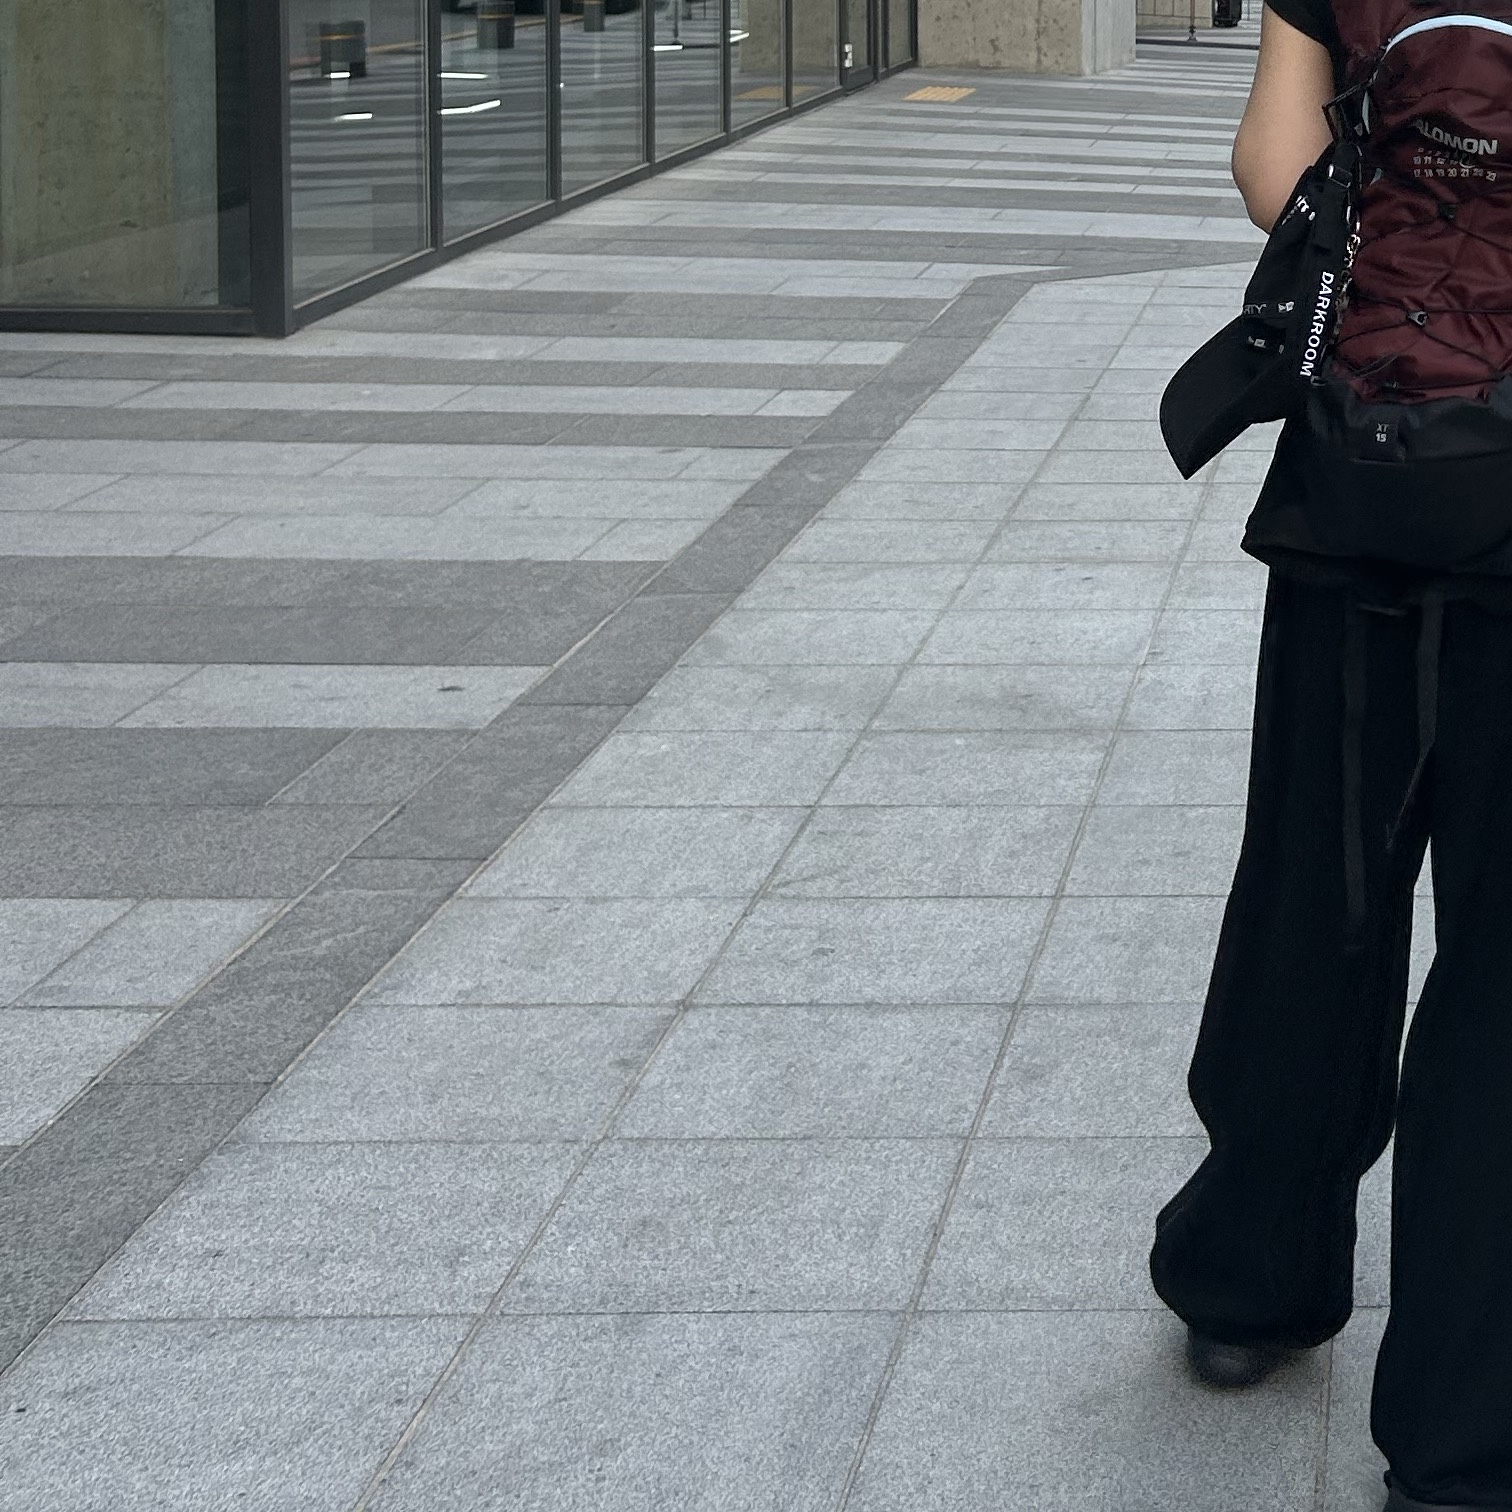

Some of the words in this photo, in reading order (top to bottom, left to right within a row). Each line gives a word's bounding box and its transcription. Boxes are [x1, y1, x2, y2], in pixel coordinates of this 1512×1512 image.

[1413, 119, 1498, 155] ALOMON
[1447, 167, 1458, 178] 20
[1460, 168, 1470, 178] 21
[1299, 270, 1335, 377] DARKROOM
[1376, 423, 1390, 433] XT
[1375, 432, 1387, 442] 15
